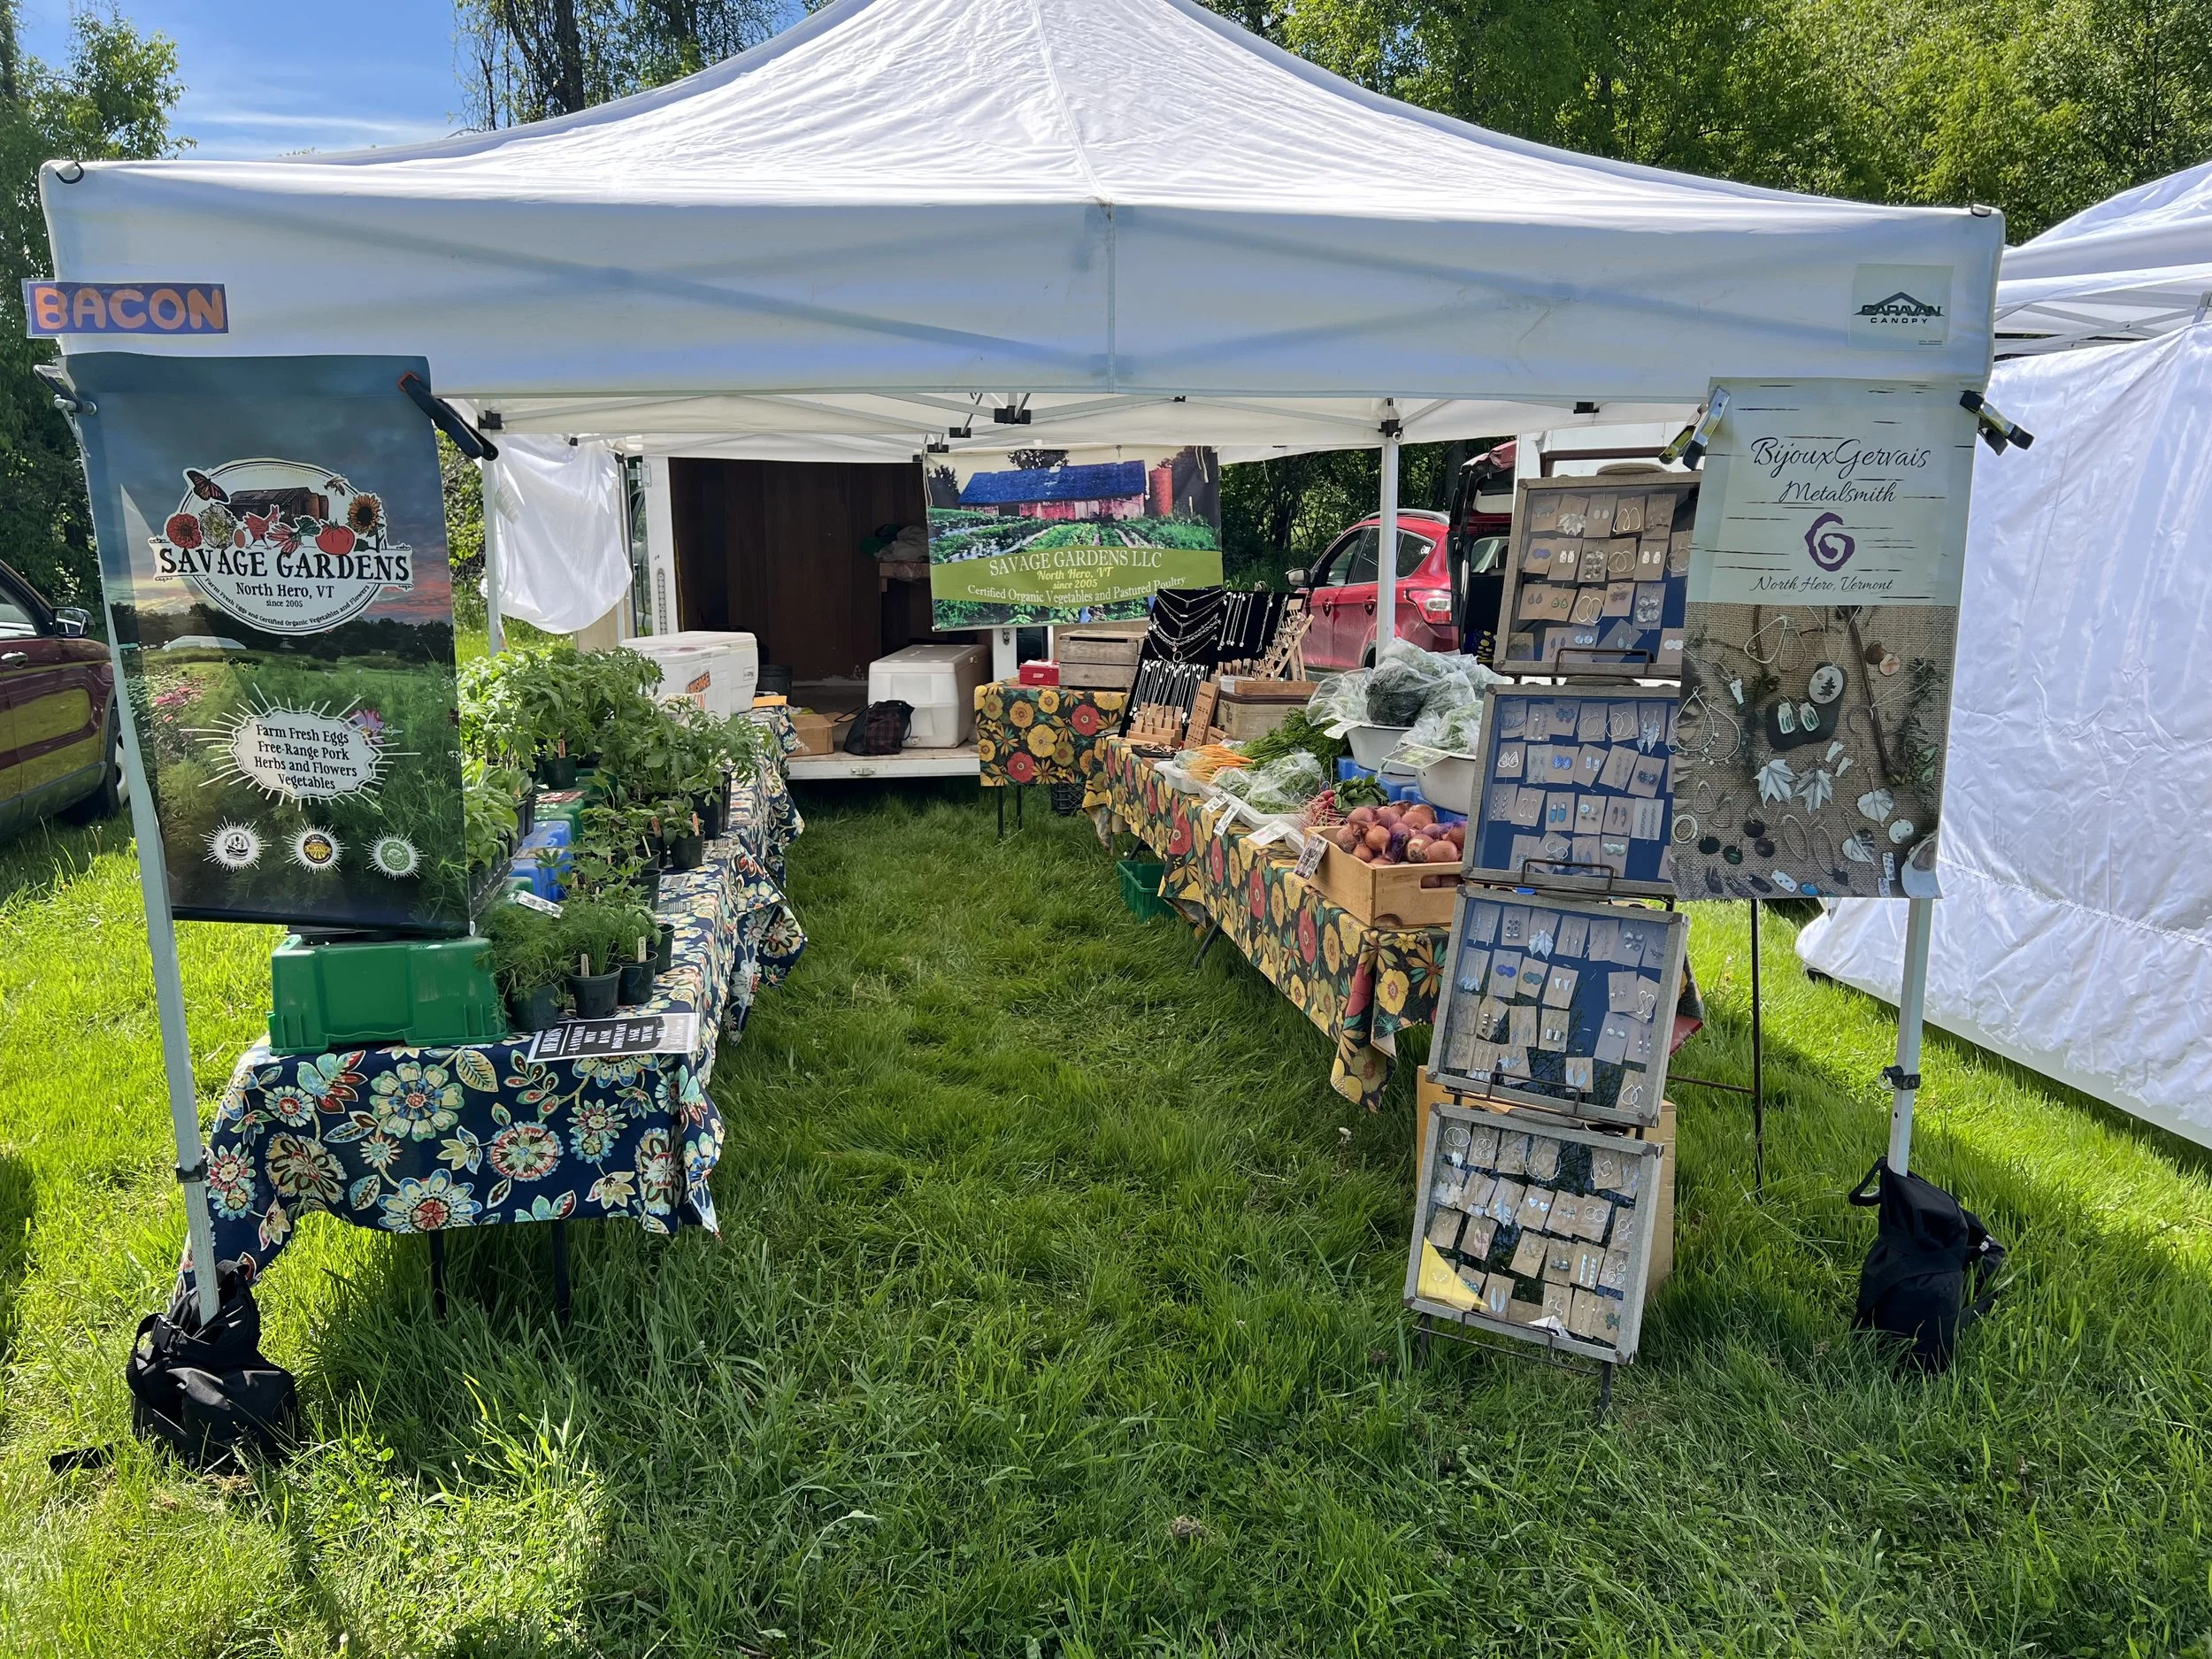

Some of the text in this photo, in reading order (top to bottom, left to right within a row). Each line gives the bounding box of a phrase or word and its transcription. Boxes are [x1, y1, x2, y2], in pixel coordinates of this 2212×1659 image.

[35, 287, 224, 330] BACON
[1861, 304, 1941, 317] CARAVAN
[1750, 436, 1932, 479] BijouxGervais
[1778, 480, 1896, 503] Metalsmith
[159, 547, 410, 581] SAVAGE GARDENS
[989, 549, 1162, 577] SAVAGE GARDENS LLC
[1036, 566, 1114, 580] North Hero, VT
[235, 582, 334, 599] North Hero, VT
[967, 576, 1186, 606] Certified Organic Vegetables and Pastured Poultry
[1052, 579, 1097, 590] since 2005
[1749, 575, 1893, 593] North Hero, Vermont
[204, 577, 220, 595] Farm
[219, 591, 234, 606] Fresh
[235, 602, 248, 614] Eggs
[259, 615, 284, 626] Certified
[309, 609, 340, 626] Vegetables
[339, 603, 350, 612] and
[349, 584, 370, 605] Flowers
[266, 599, 284, 608] since
[256, 724, 349, 747] Farm Fresh Eggs
[257, 741, 350, 761] Free-Range Pork
[254, 756, 357, 777] Herbs and Flowers
[278, 773, 336, 789] Vegetables
[540, 1028, 564, 1053] HERBS
[568, 1025, 587, 1051] LAVENDER
[611, 1023, 627, 1049] ROSEMARY
[627, 1027, 641, 1042] SAGE
